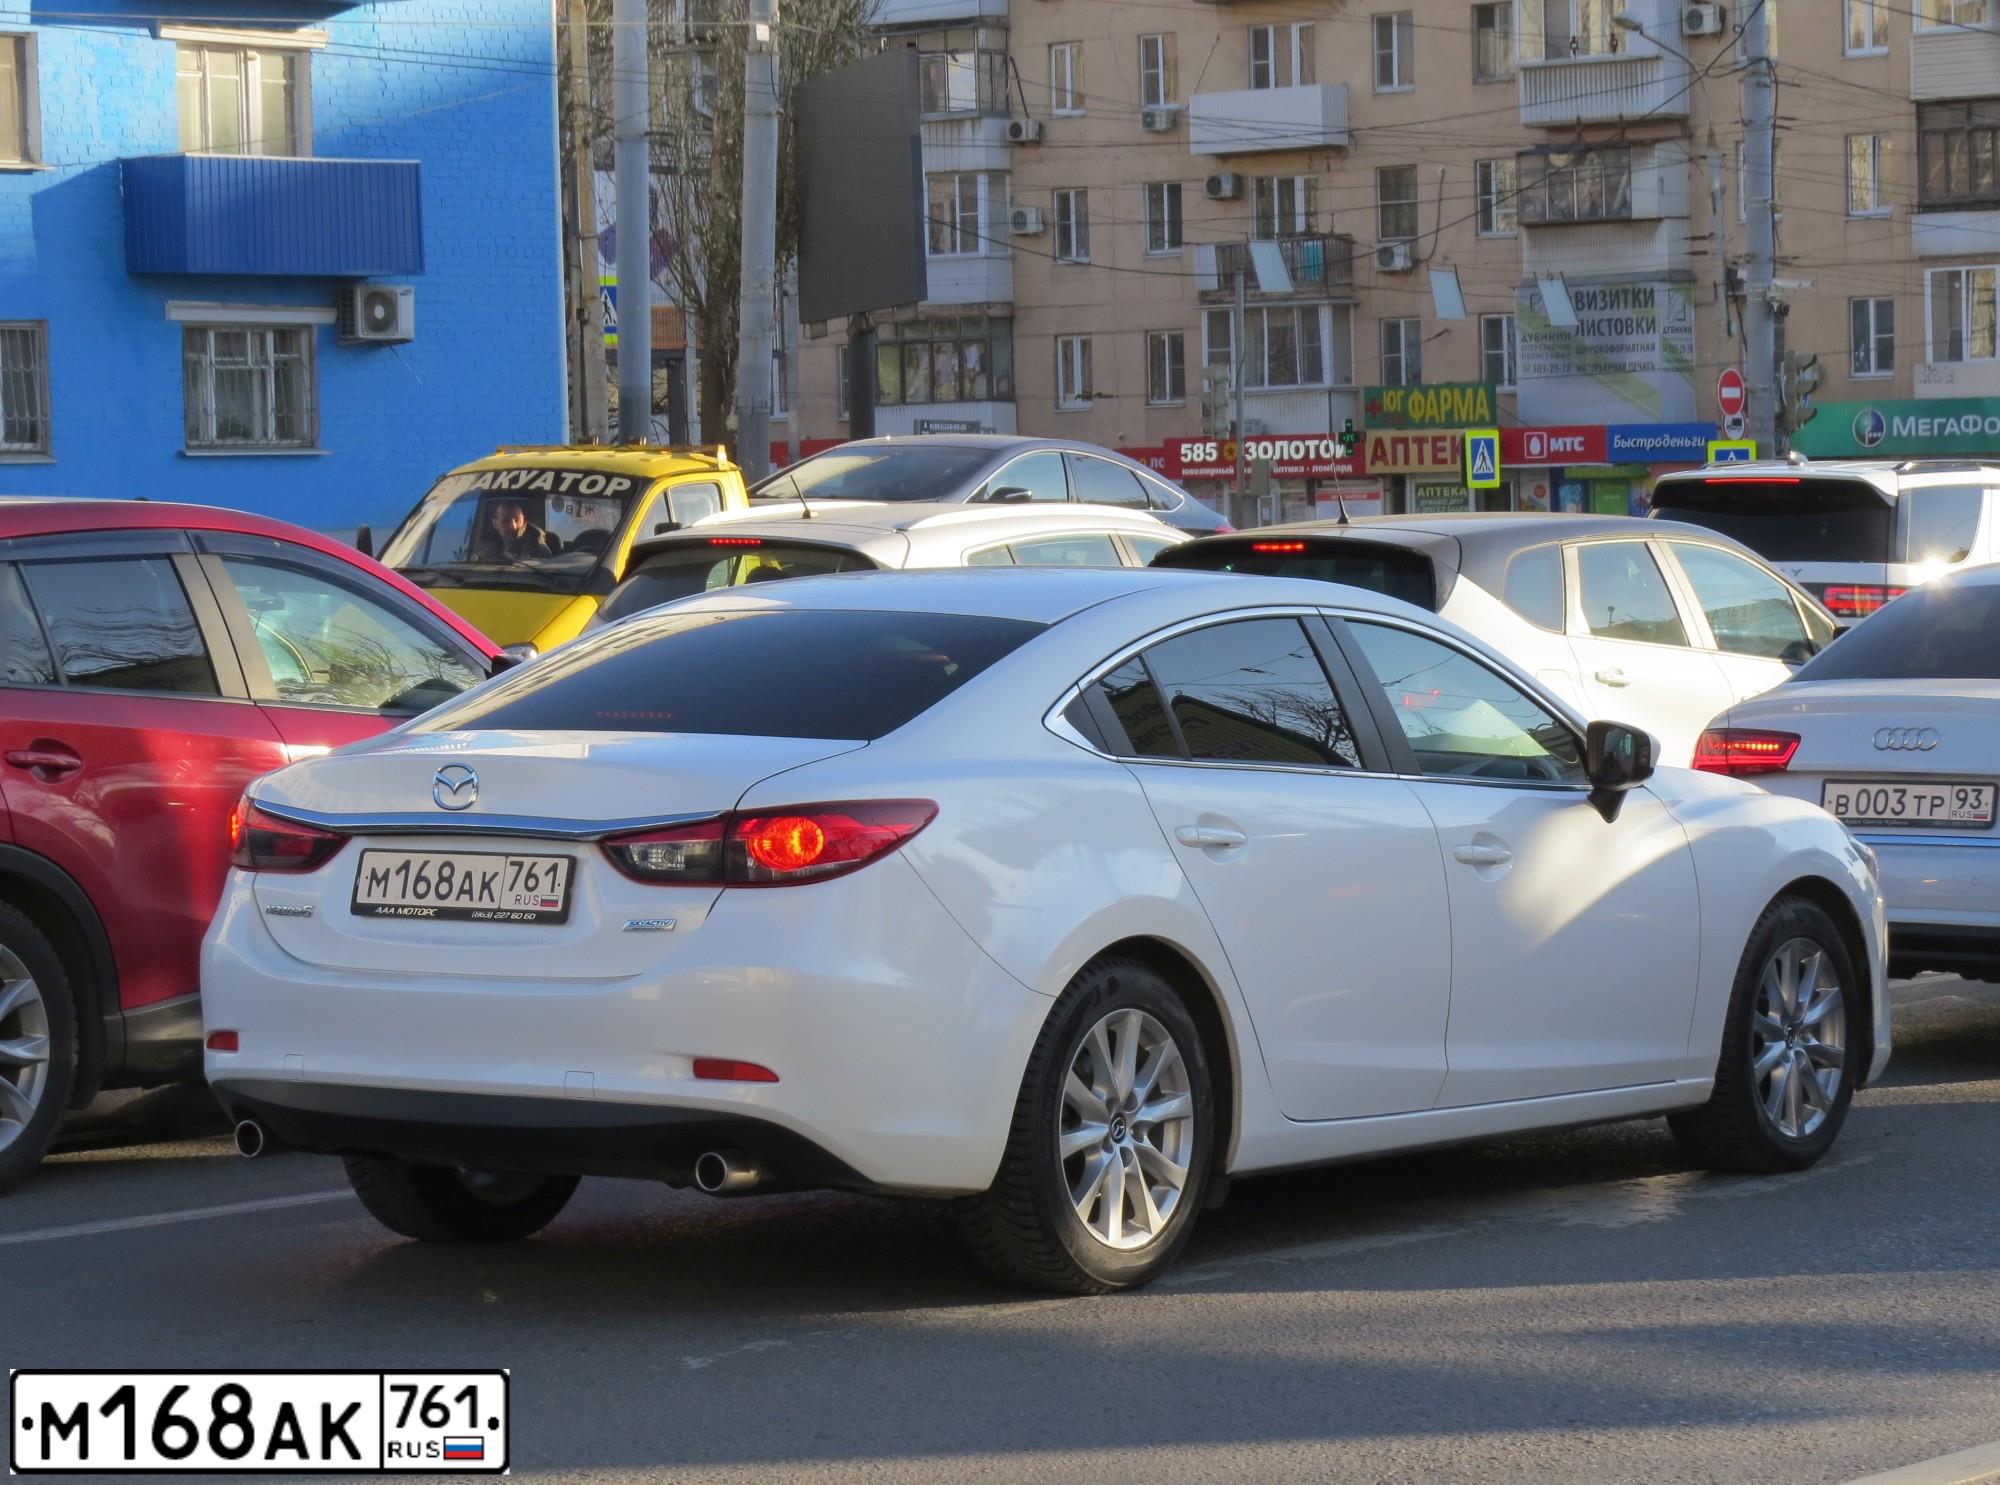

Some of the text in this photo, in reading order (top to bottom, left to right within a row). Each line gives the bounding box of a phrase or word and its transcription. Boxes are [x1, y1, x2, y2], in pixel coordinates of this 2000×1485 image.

[1574, 287, 1655, 312] ВИЗИТКИ
[1574, 316, 1657, 337] ЛИСТОВКИ
[1382, 386, 1491, 423] ЮГ ФАРМА
[1369, 435, 1461, 466] АПТЕК
[1550, 436, 1585, 453] МТС
[1613, 435, 1706, 452] Быстроденьги
[1180, 442, 1218, 463] 585
[1181, 464, 1234, 477] ювелирный
[1273, 463, 1353, 474] оптика ломбард
[1416, 486, 1467, 497] АПТЕКА
[1955, 788, 1984, 810] 93
[1951, 810, 1972, 819] RUS
[366, 859, 558, 904] М168АК 761
[514, 894, 540, 906] RUS
[396, 907, 439, 917] МОТОРС
